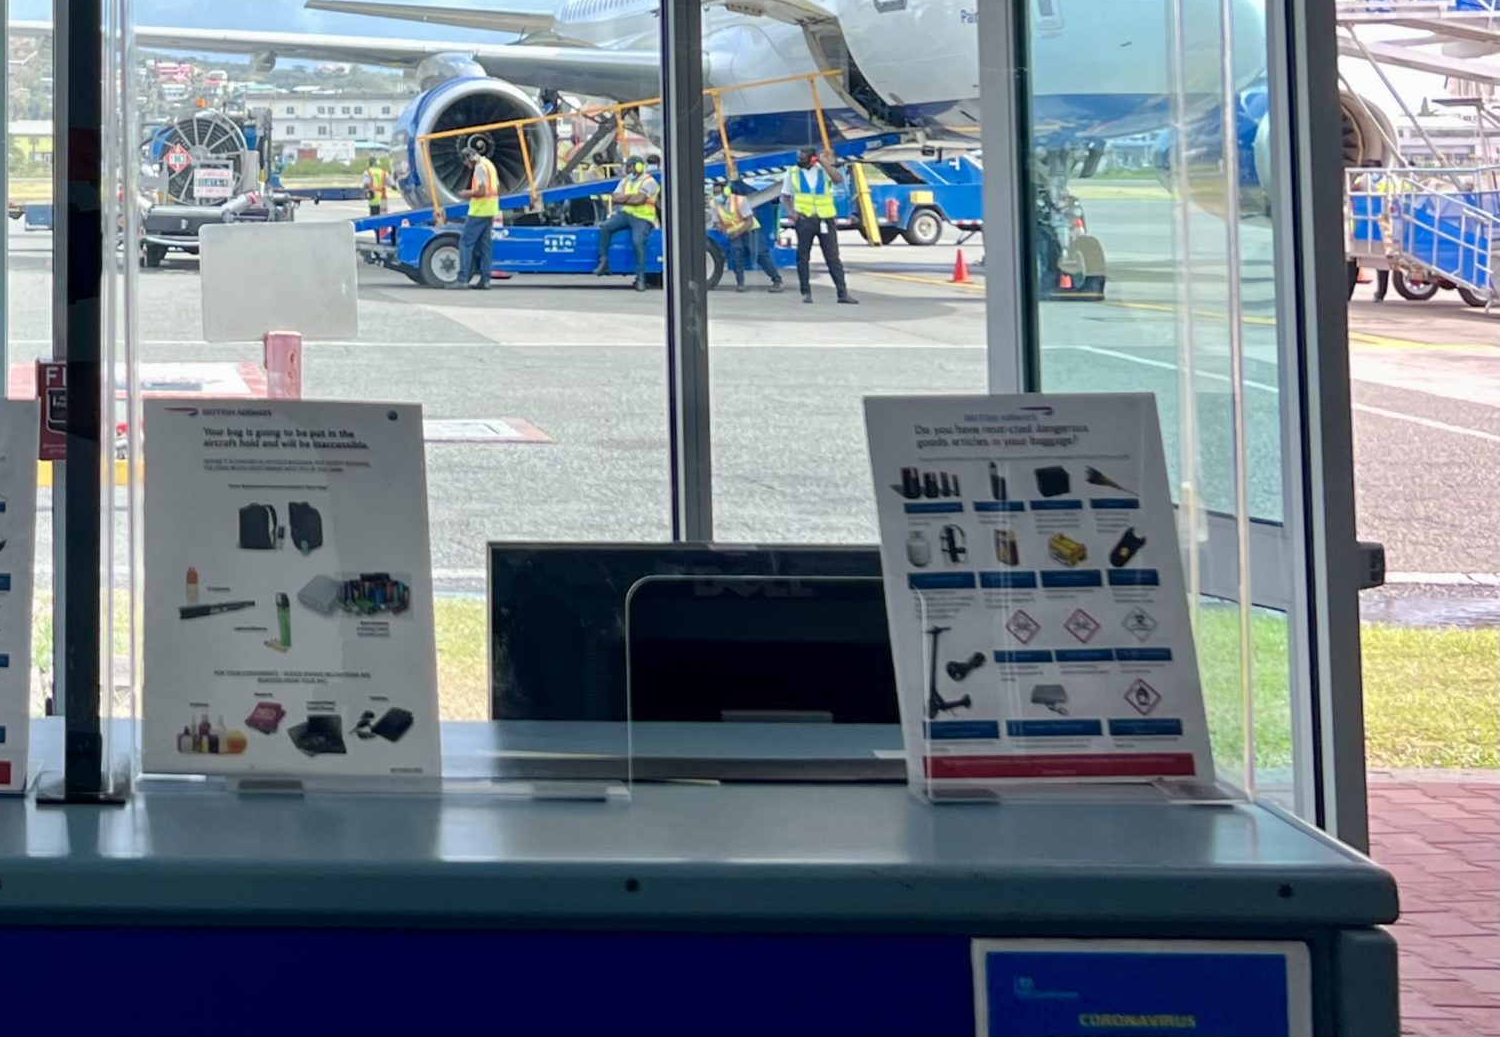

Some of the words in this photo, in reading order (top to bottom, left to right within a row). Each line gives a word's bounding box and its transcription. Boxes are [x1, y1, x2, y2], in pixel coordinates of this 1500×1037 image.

[203, 426, 223, 435] Your
[226, 427, 243, 438] bag
[246, 427, 253, 436] is
[256, 429, 280, 438] going
[296, 428, 308, 436] be
[309, 430, 325, 439] put
[328, 428, 337, 437] in
[339, 428, 354, 438] the
[914, 424, 930, 435] Do
[934, 426, 954, 435] you
[954, 424, 980, 434] have
[1035, 423, 1090, 435] dangerous
[203, 438, 237, 447] aircraft
[239, 438, 260, 447] hold
[262, 439, 279, 447] and
[281, 439, 297, 447] will
[299, 439, 310, 448] be
[916, 437, 949, 449] goods
[951, 436, 989, 447] articles
[1004, 438, 1028, 448] your
[1028, 434, 1079, 448] baggage?
[1079, 1013, 1197, 1028] CORONAVIRUS
